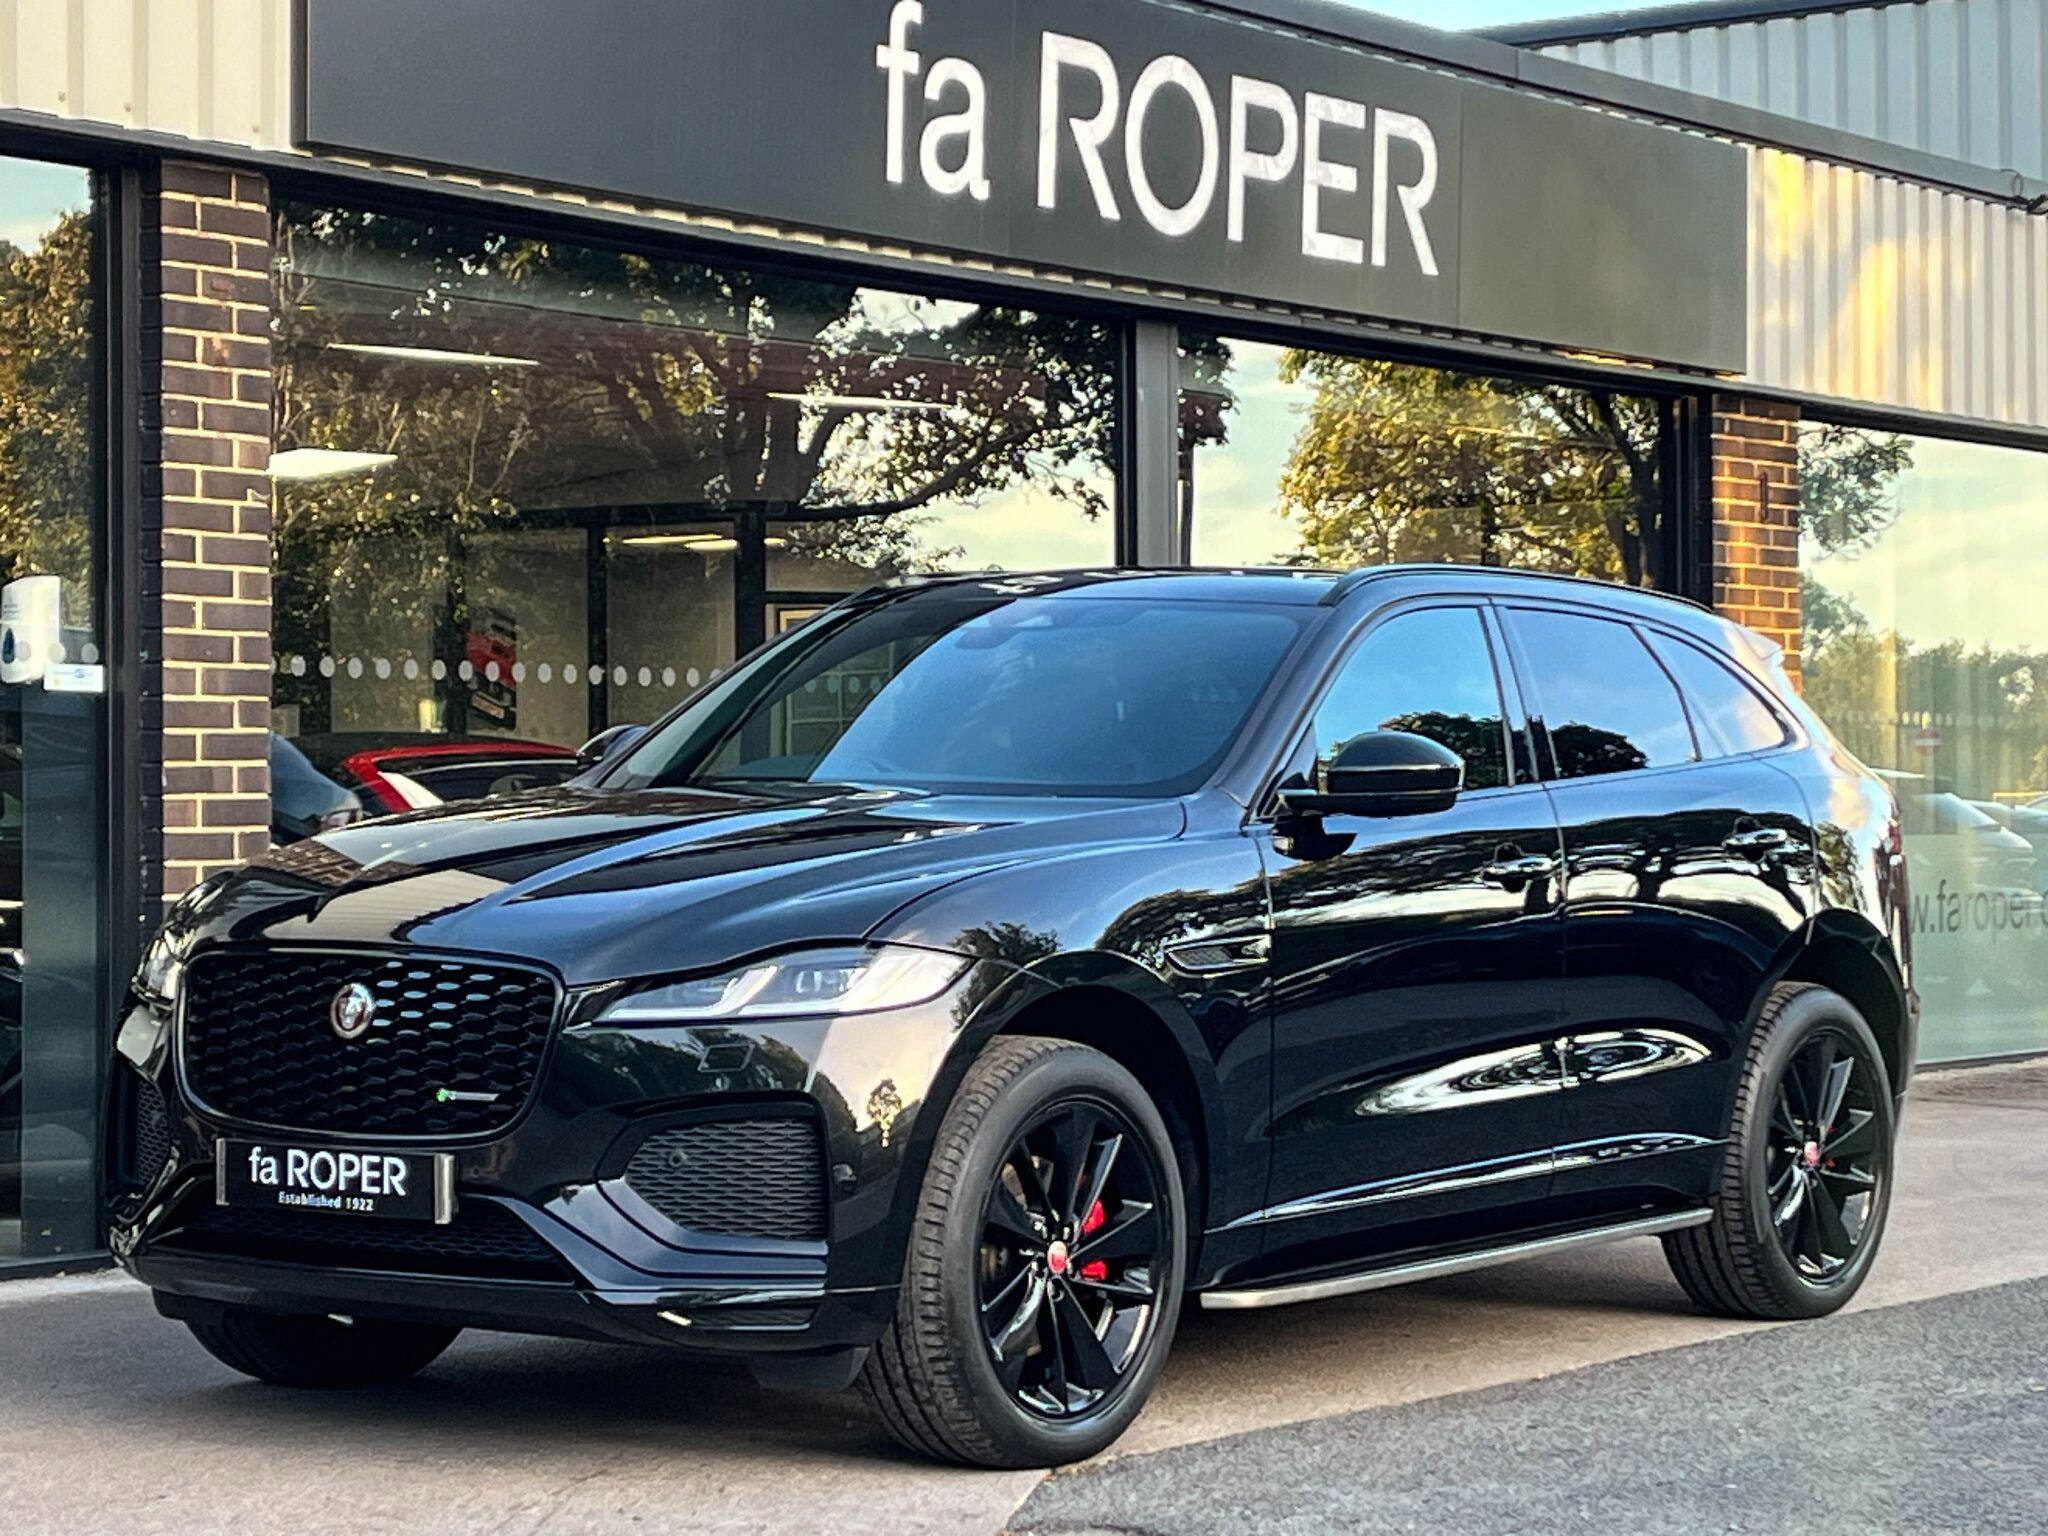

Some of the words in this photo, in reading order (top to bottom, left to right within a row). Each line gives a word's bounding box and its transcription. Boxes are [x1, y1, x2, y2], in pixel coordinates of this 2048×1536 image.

[876, 0, 991, 200] fa
[1037, 31, 1439, 276] ROPER
[248, 1146, 278, 1185] fa
[287, 1149, 406, 1196] ROPER
[278, 1191, 341, 1209] Established
[345, 1198, 374, 1211] 1922
